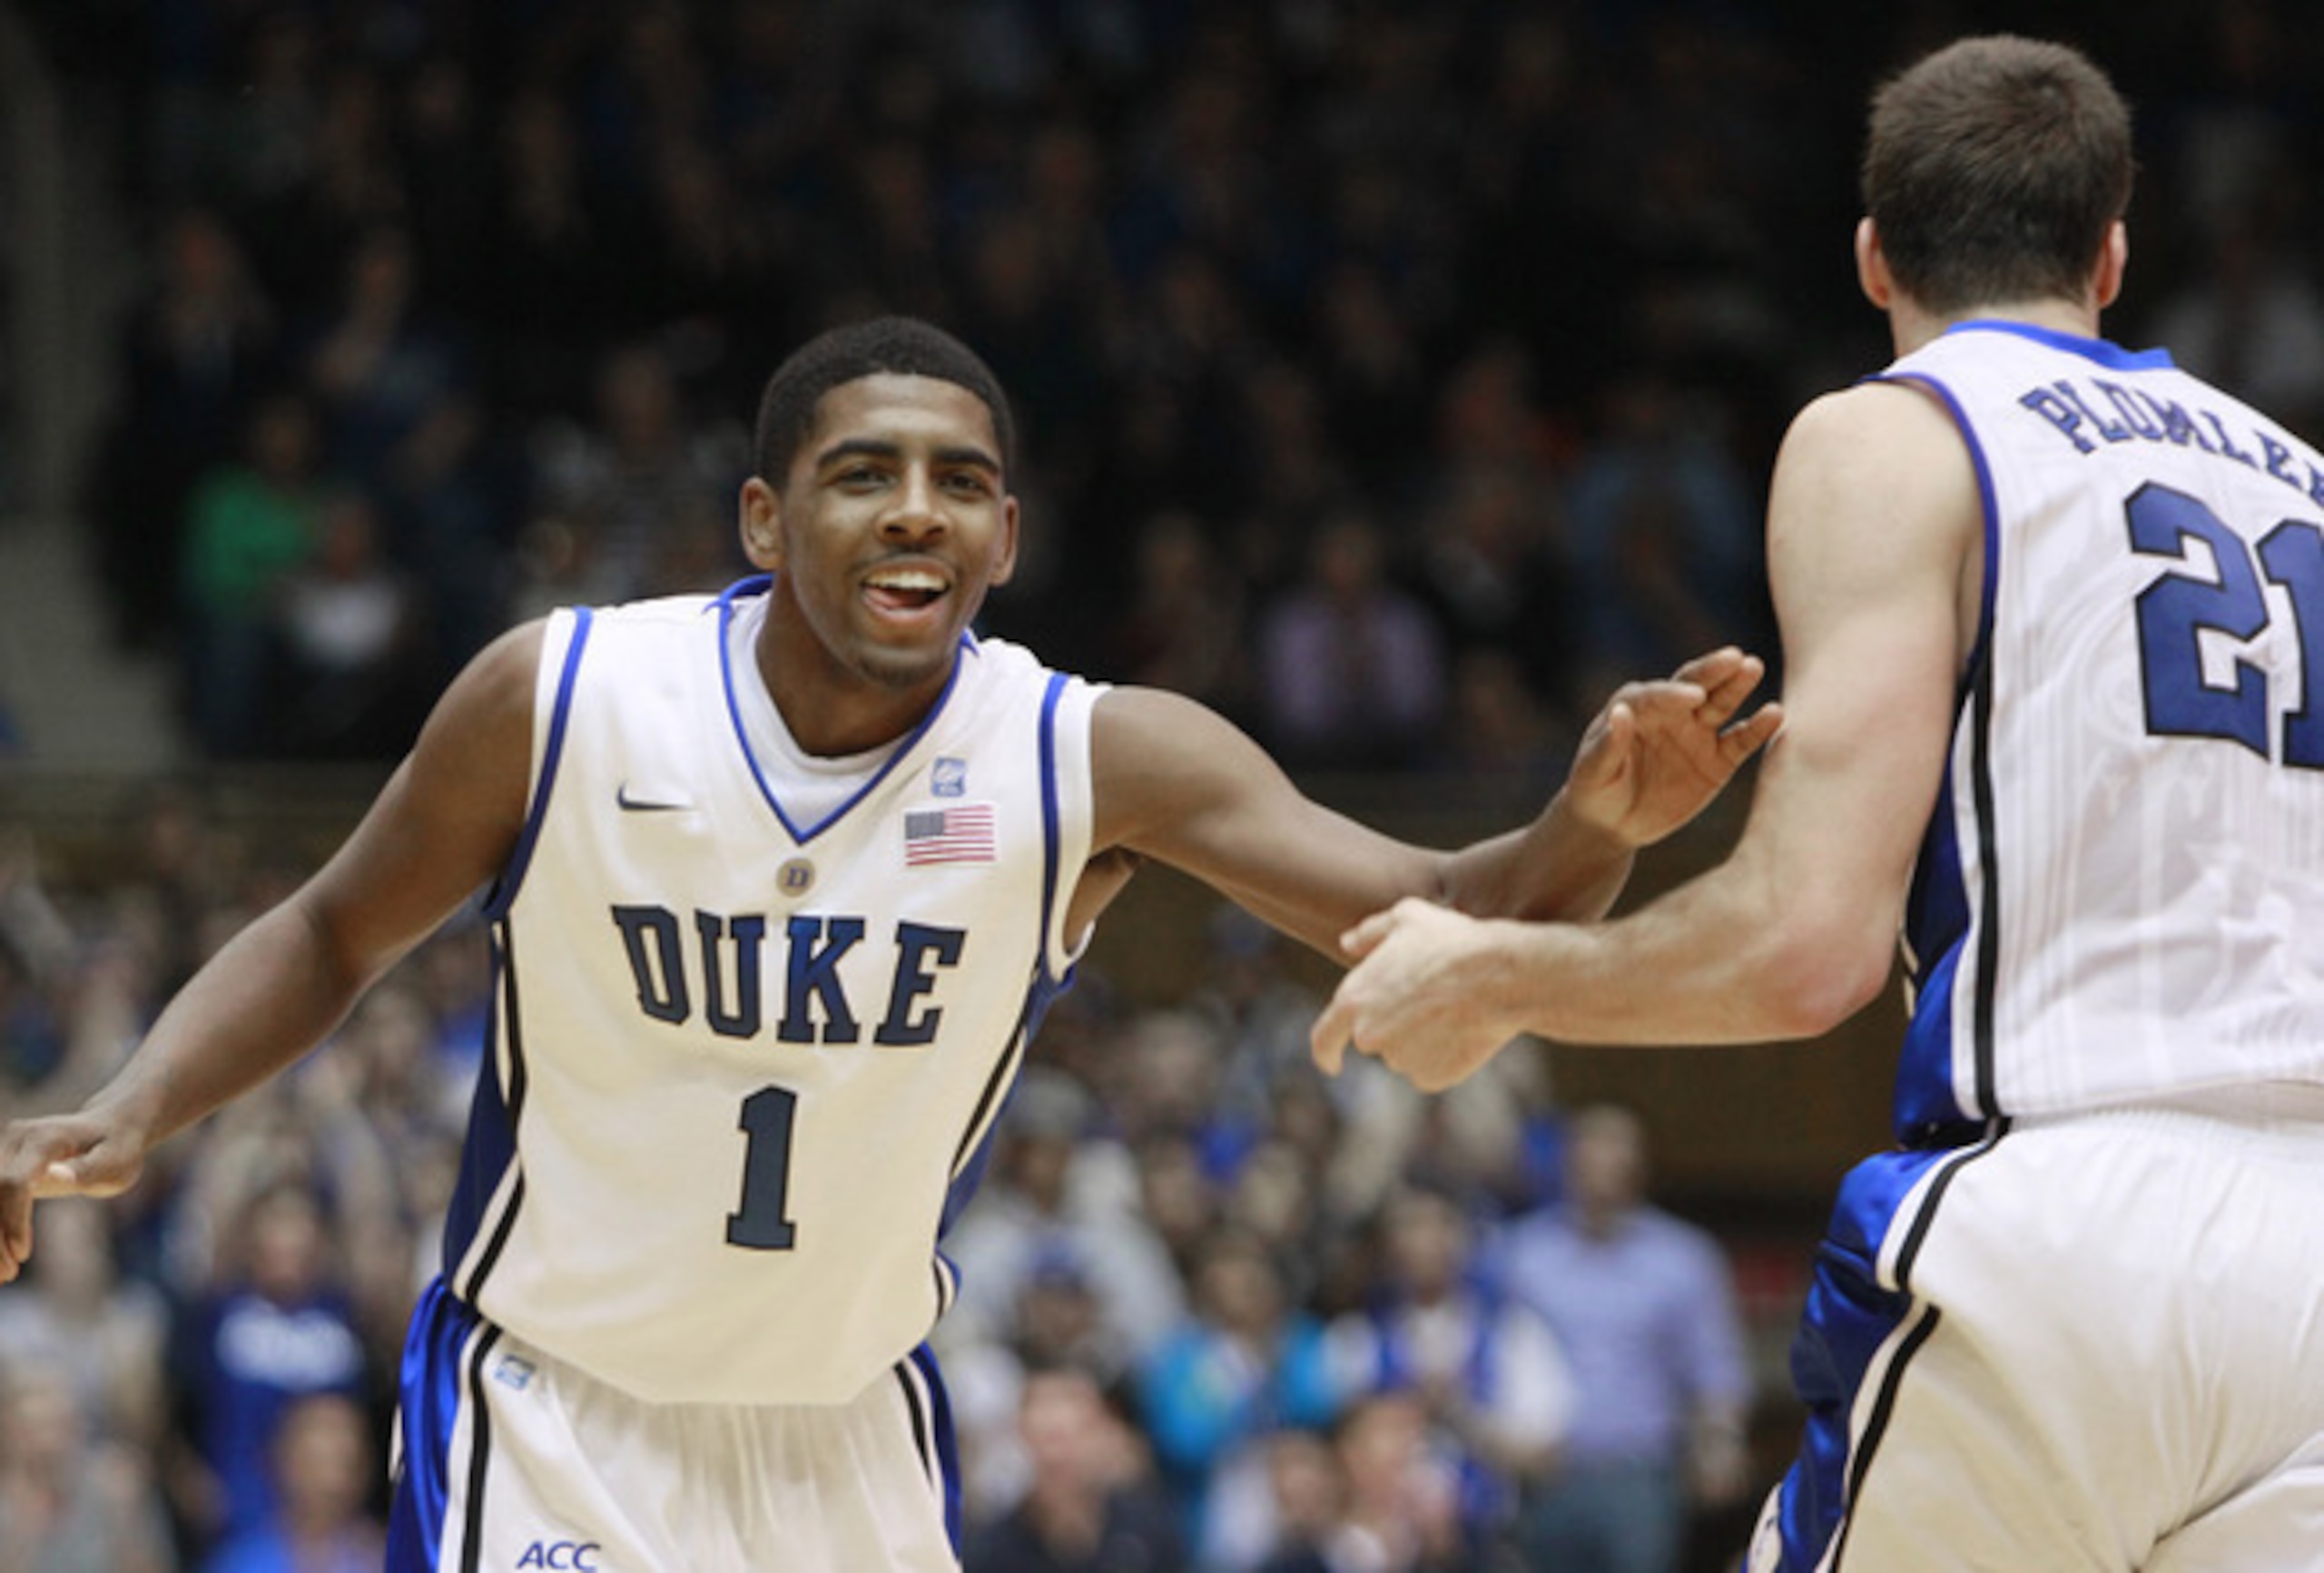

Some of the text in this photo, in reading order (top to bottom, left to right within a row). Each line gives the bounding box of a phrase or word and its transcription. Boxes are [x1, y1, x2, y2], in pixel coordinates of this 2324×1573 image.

[2123, 479, 2324, 771] 21
[787, 867, 809, 886] D
[610, 904, 968, 1047] DUKE
[724, 1084, 798, 1251] 1
[515, 1540, 601, 1573] ACC
